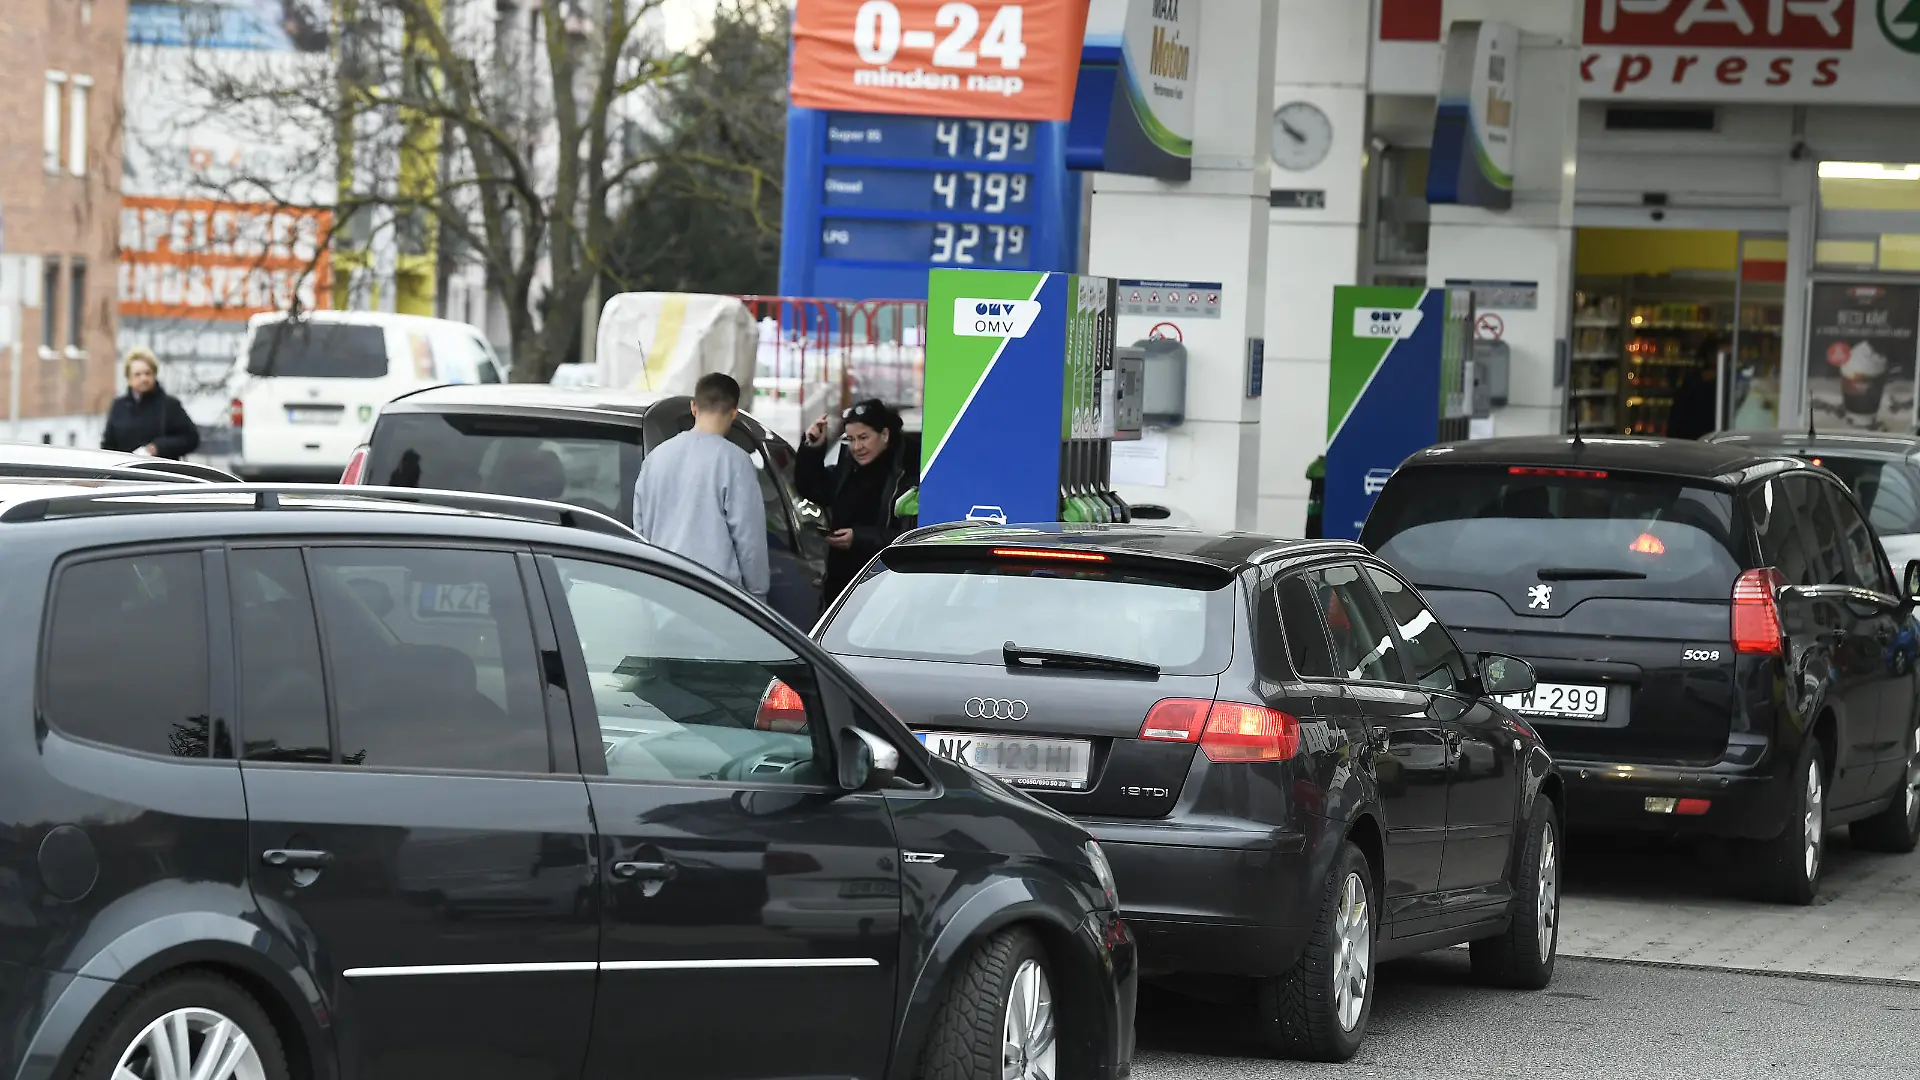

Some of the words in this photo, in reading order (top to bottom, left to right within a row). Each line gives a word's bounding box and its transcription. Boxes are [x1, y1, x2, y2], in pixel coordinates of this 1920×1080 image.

[853, 0, 1027, 70] 0-24
[1150, 25, 1189, 80] Motion
[854, 67, 960, 90] minden
[967, 74, 1024, 96] nap
[822, 228, 849, 245] LPG
[975, 320, 1014, 333] OMV
[1370, 324, 1402, 335] OMV
[1683, 649, 1720, 661] 5008
[1489, 687, 1598, 712] W-299
[938, 738, 971, 767] NK
